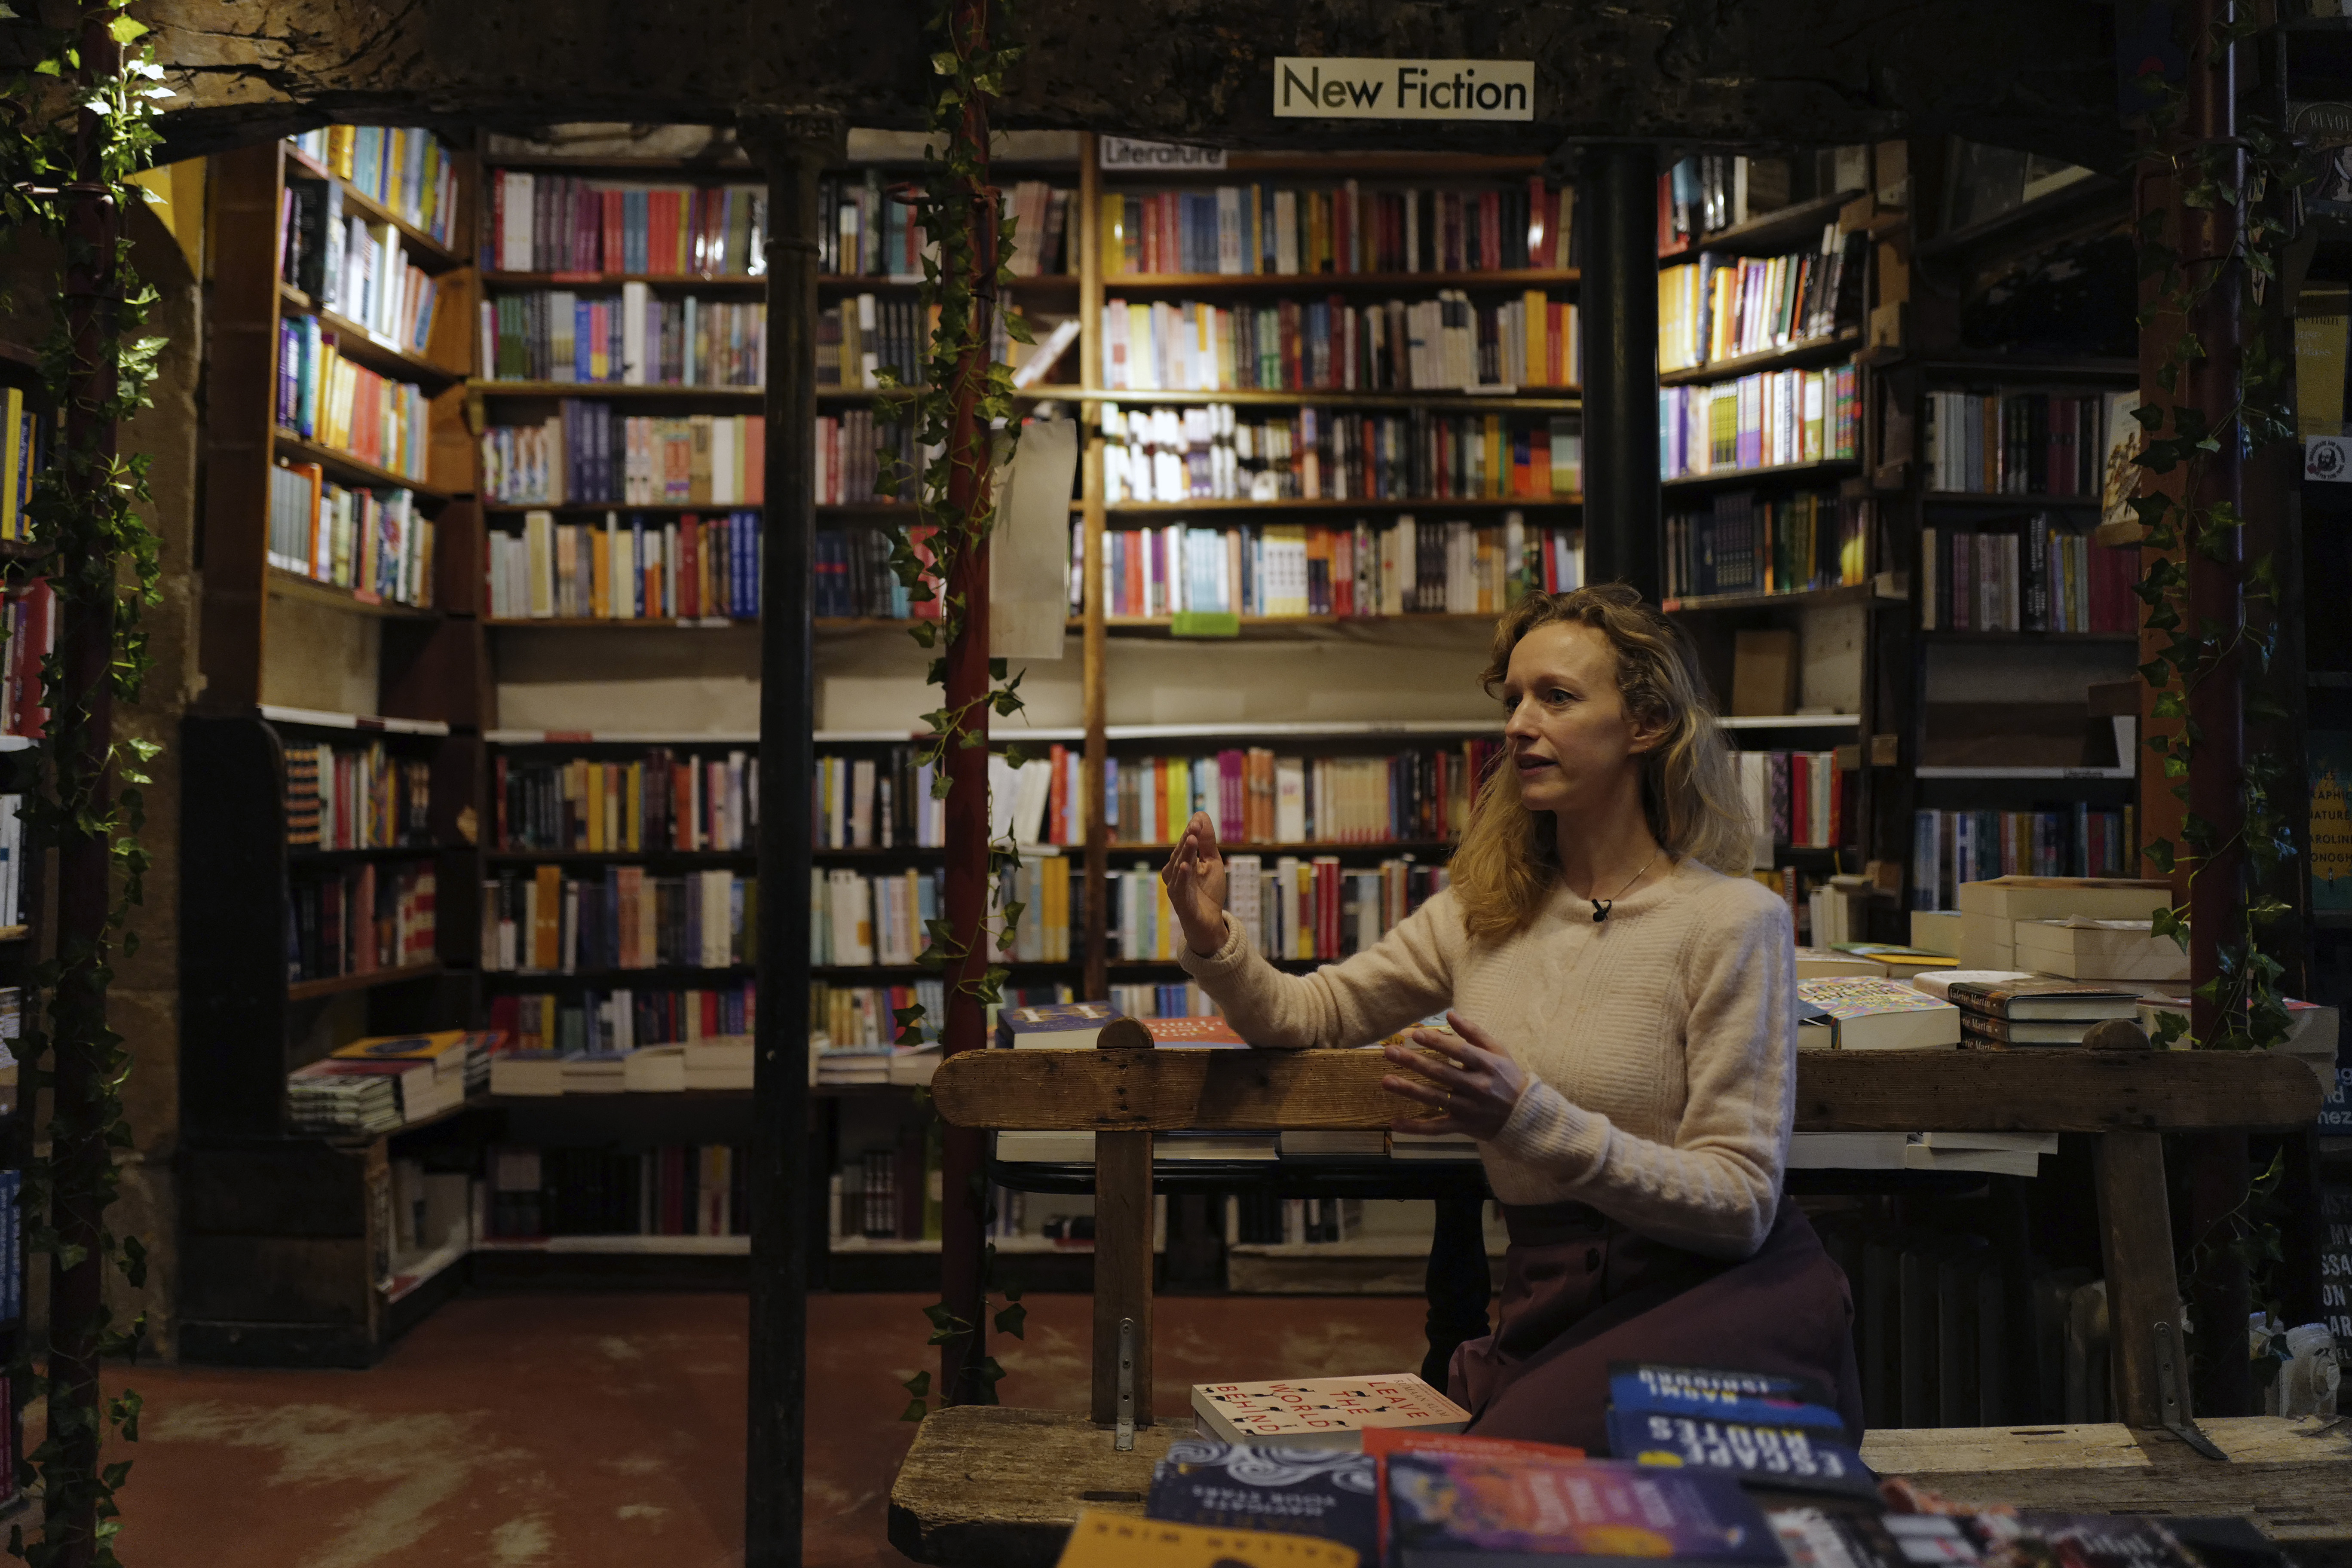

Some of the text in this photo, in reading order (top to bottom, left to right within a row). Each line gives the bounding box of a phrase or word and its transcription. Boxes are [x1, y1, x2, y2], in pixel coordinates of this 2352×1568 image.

[1283, 64, 1527, 110] New Fiction
[1105, 137, 1222, 165] Literature
[1950, 988, 1991, 1008] Valerie Martin
[1972, 1019, 1993, 1033] Martin
[1216, 1386, 1280, 1432] BEHIND
[1268, 1384, 1330, 1428] WORLD
[1329, 1391, 1370, 1415] THE
[1368, 1381, 1430, 1418] LEAVE
